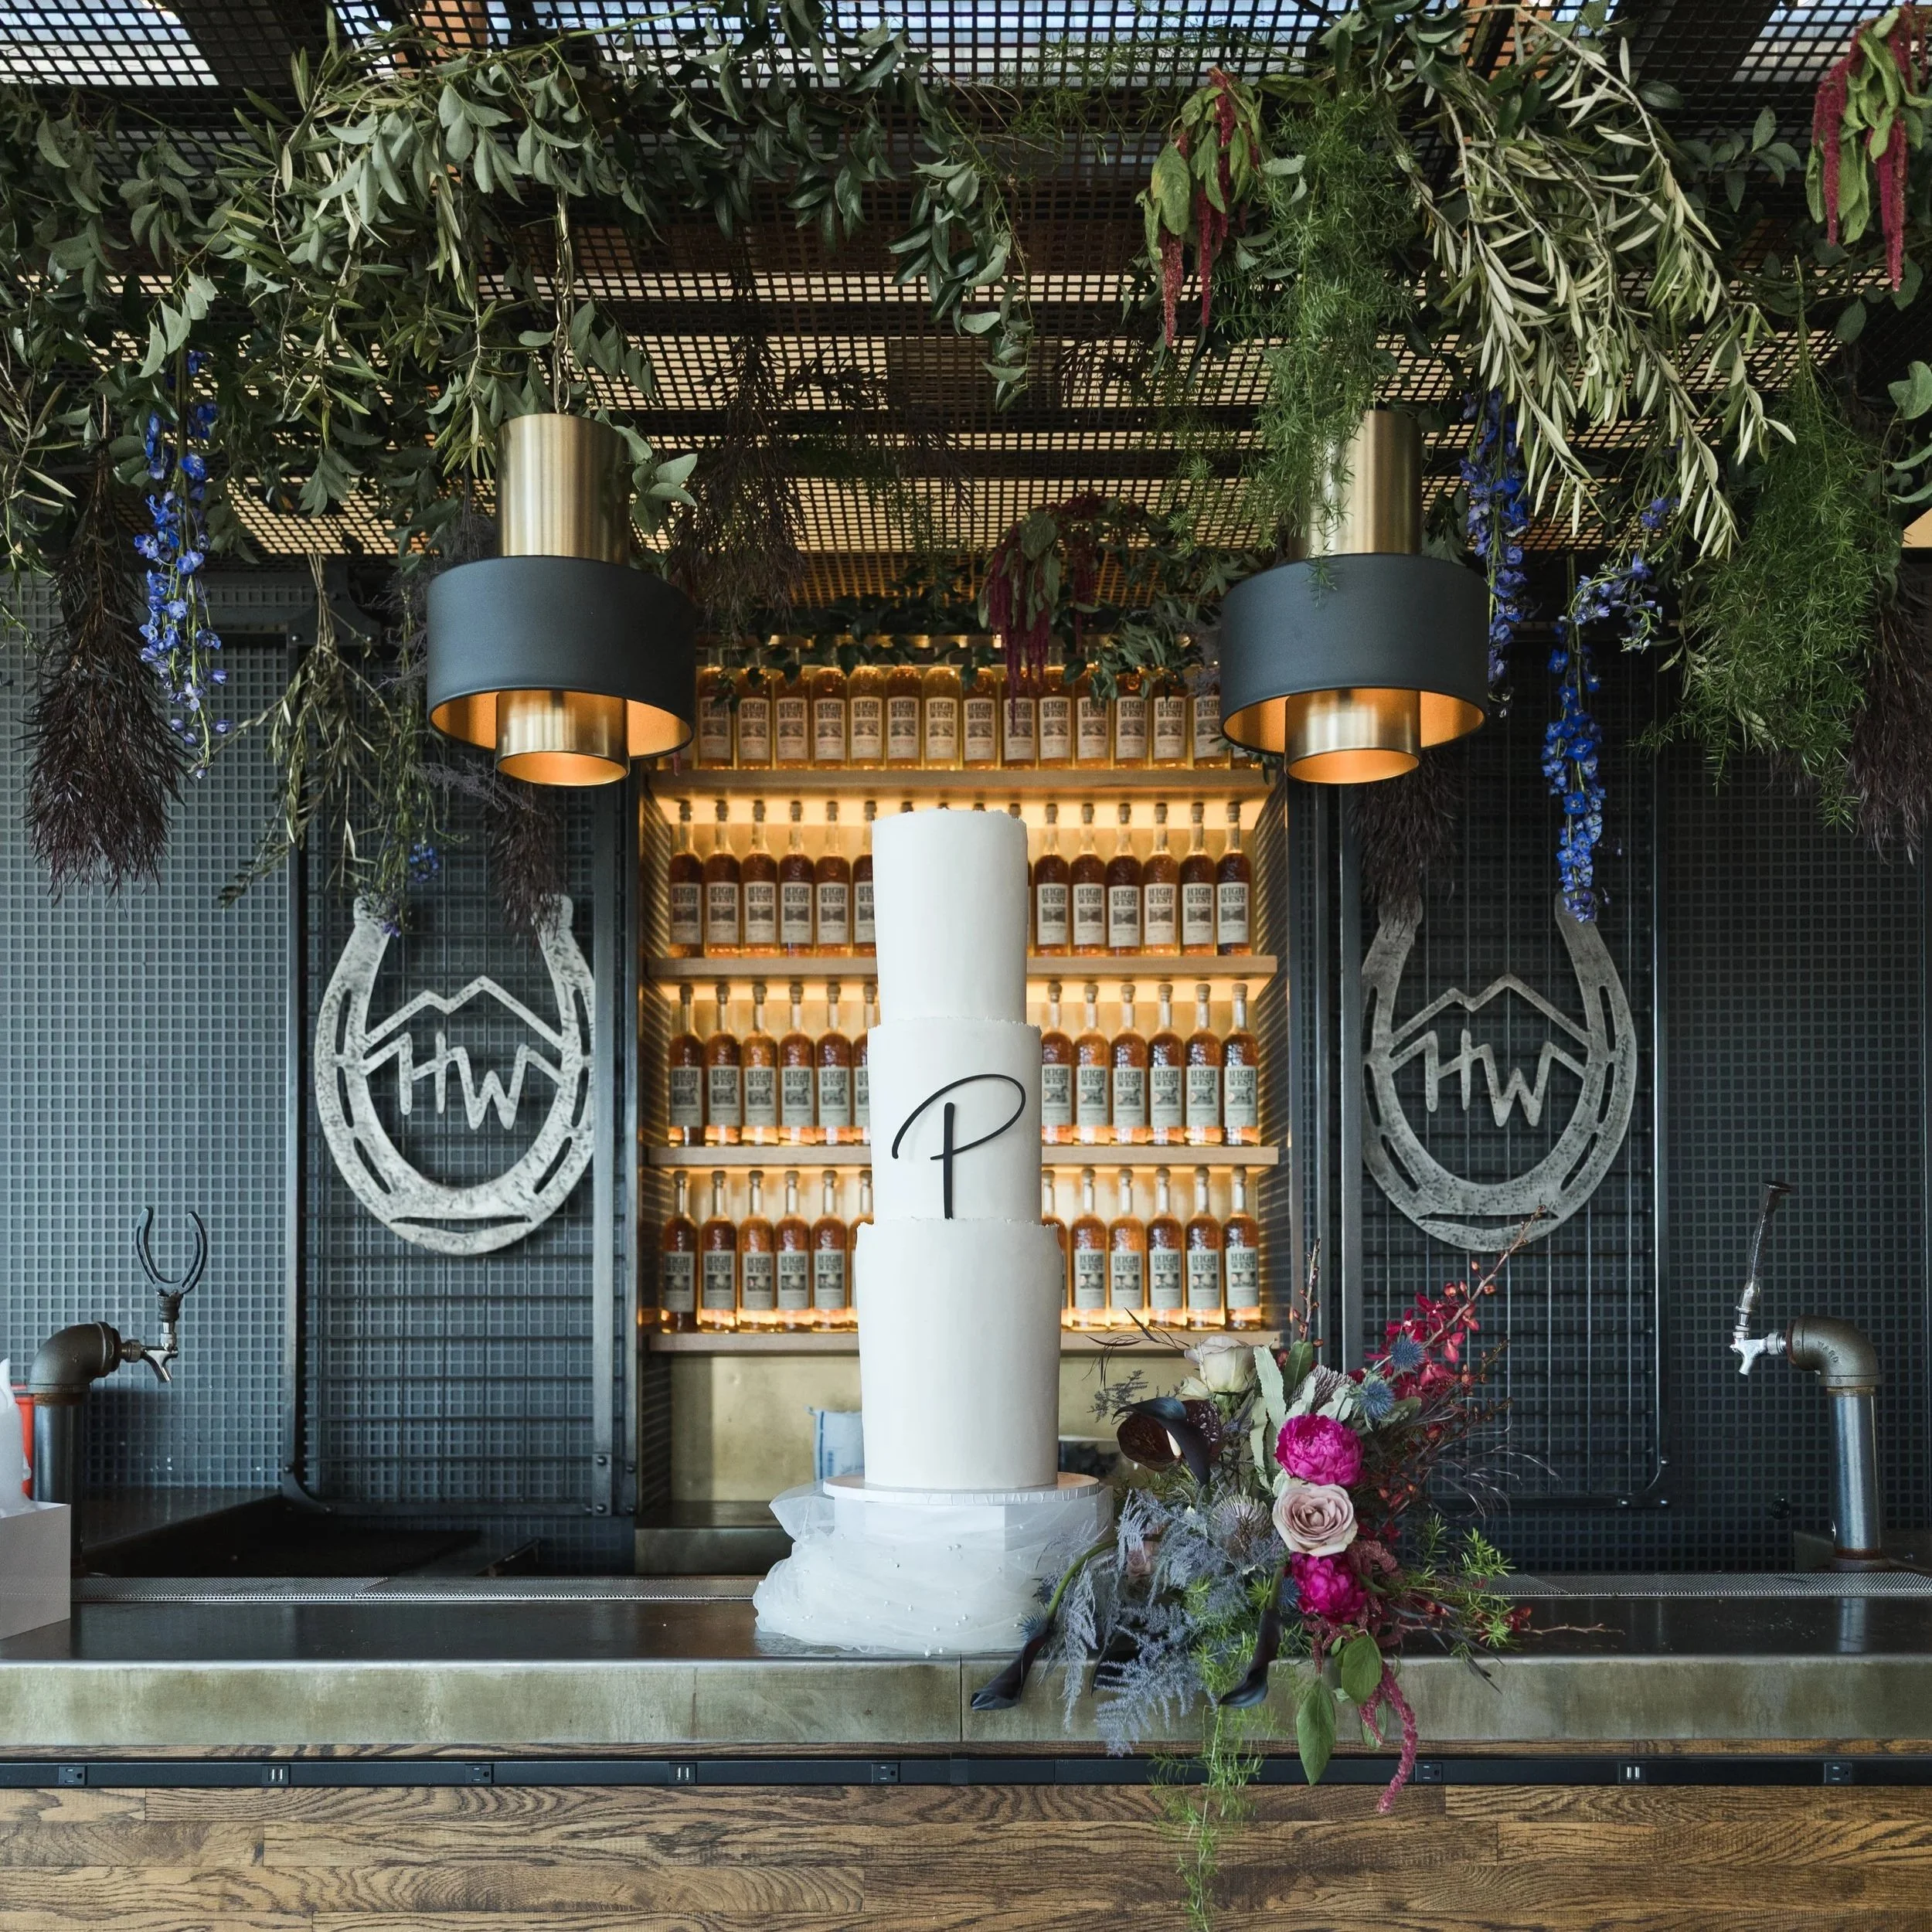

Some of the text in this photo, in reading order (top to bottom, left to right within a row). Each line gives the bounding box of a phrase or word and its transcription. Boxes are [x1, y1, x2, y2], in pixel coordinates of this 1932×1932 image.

[968, 702, 991, 712] HIGH
[1043, 702, 1066, 711] HIGH
[1082, 702, 1106, 710] HI
[1121, 701, 1145, 710] HIGH
[1042, 888, 1066, 897] HIGH
[1078, 889, 1101, 897] HIGH
[1113, 891, 1138, 900] HIGH
[1148, 888, 1172, 897] HIGH
[1187, 888, 1211, 897] HIGH
[1221, 888, 1245, 896] HIGH
[1044, 1068, 1068, 1078] HIGH
[1080, 1070, 1105, 1079] HIGH
[1117, 1071, 1141, 1080] HIGH
[1155, 1070, 1179, 1079] HIGH
[1191, 1070, 1216, 1079] HIGH
[1230, 1070, 1253, 1079] HIGH
[380, 1032, 543, 1130] HW
[1410, 1029, 1568, 1127] HW
[892, 1074, 1026, 1219] P
[1080, 1254, 1104, 1264] HIGH
[1114, 1256, 1138, 1264] HIGH
[1155, 1255, 1179, 1264] HIGH
[1192, 1255, 1216, 1264] HIGH
[1231, 1253, 1255, 1262] HIGH
